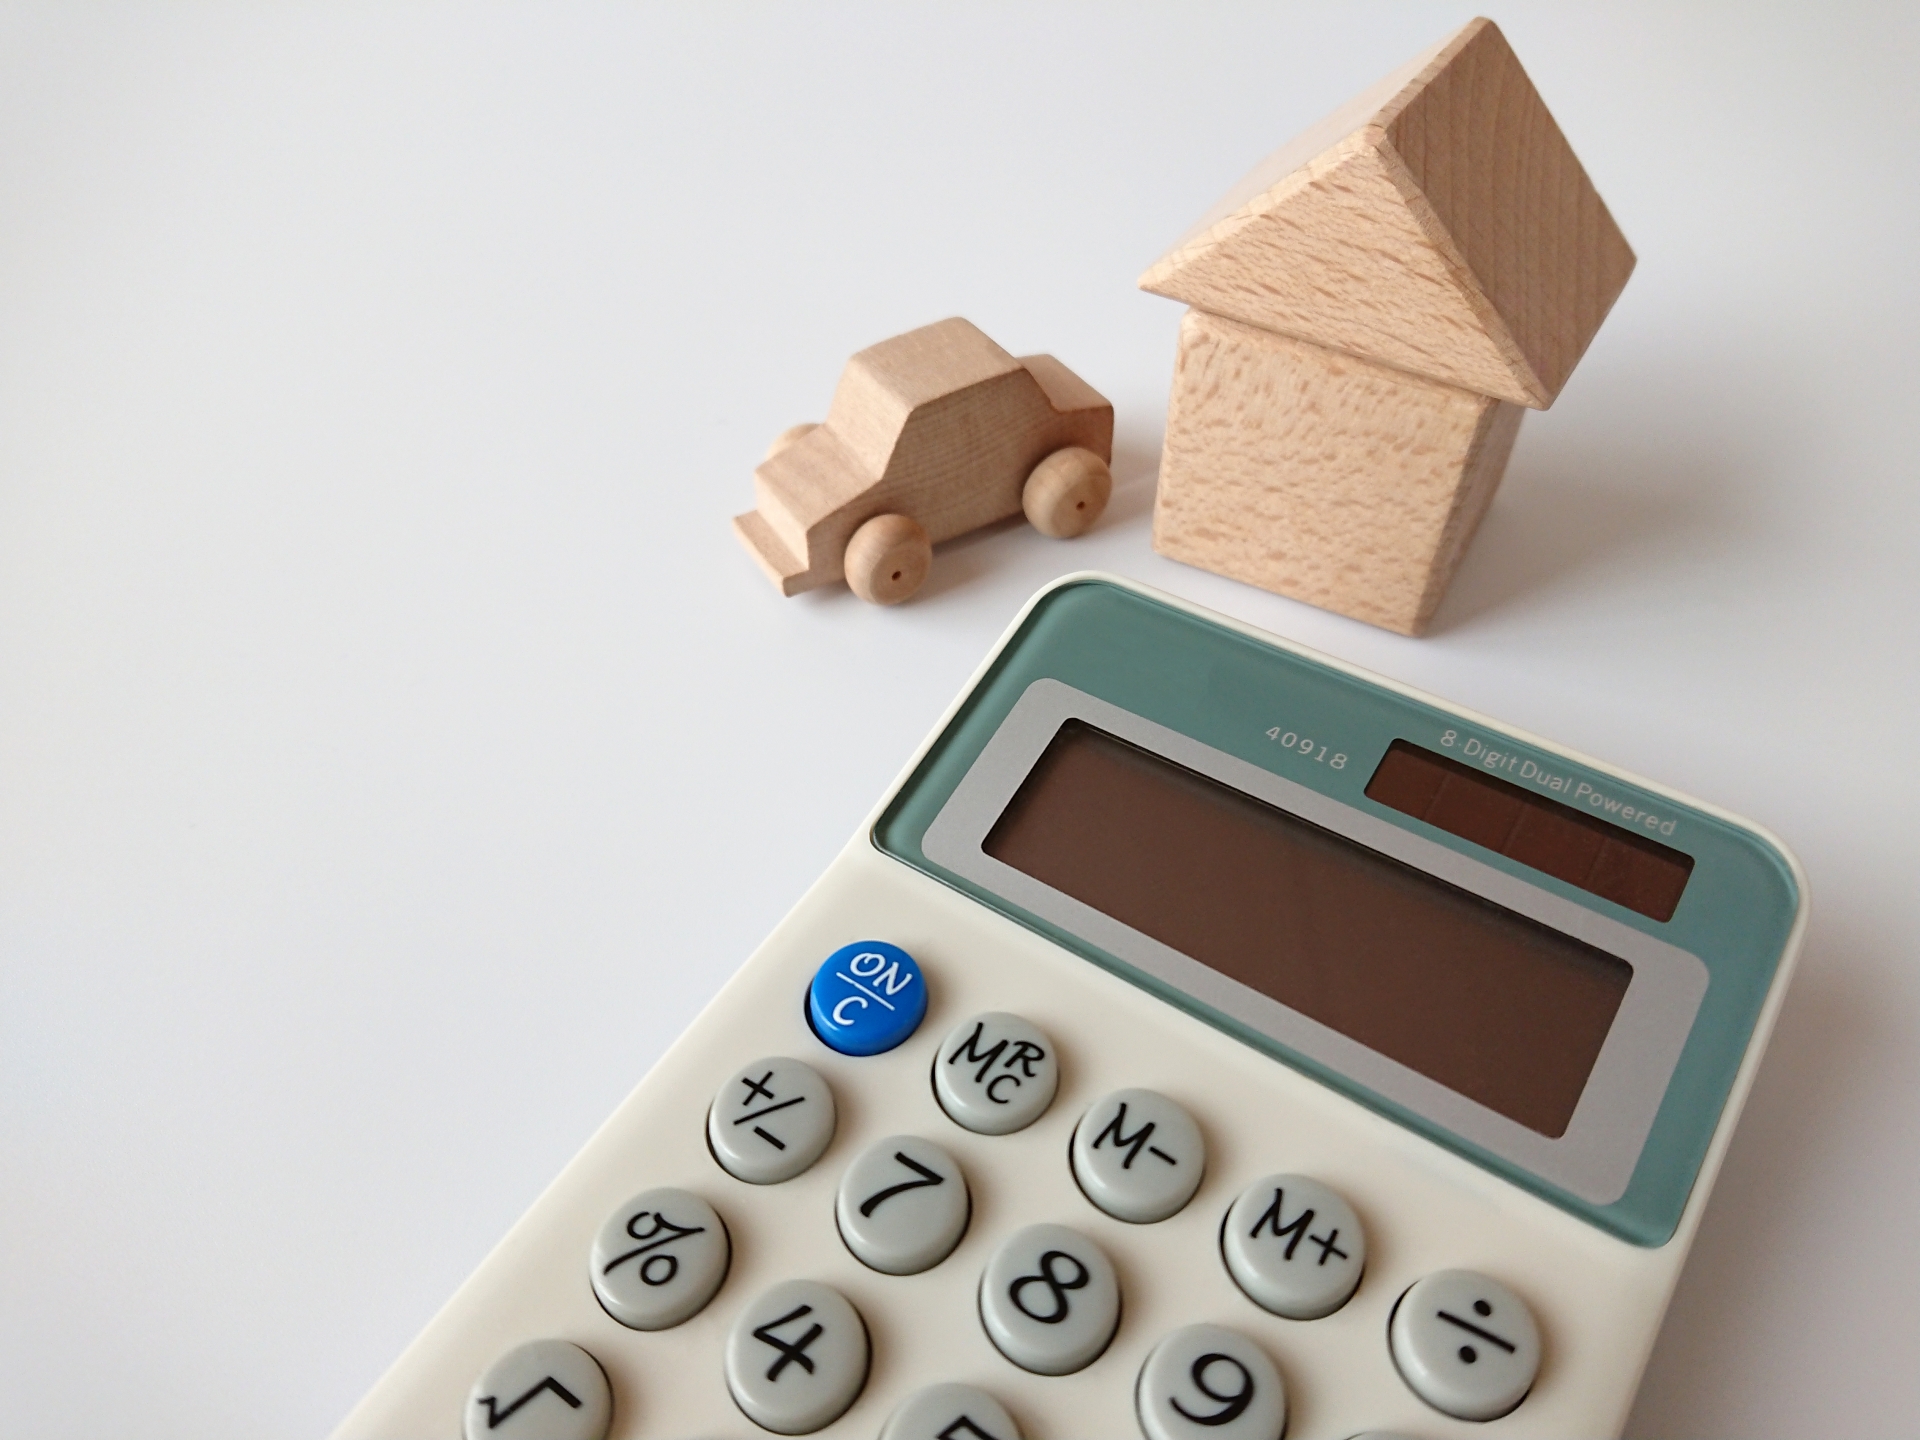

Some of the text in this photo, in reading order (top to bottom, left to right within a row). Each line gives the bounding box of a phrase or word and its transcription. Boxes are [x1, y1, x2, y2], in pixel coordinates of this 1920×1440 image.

[1264, 726, 1348, 770] 40918
[1519, 760, 1573, 793] Dual
[1574, 781, 1678, 836] Powered
[832, 996, 868, 1026] C
[849, 952, 912, 995] ON
[1092, 1102, 1178, 1170] M-
[859, 1151, 946, 1218] 7
[603, 1211, 706, 1287] %
[1249, 1187, 1349, 1267] M+
[1007, 1250, 1091, 1325] 8
[752, 1304, 825, 1383] 4
[1169, 1352, 1256, 1427] 9
